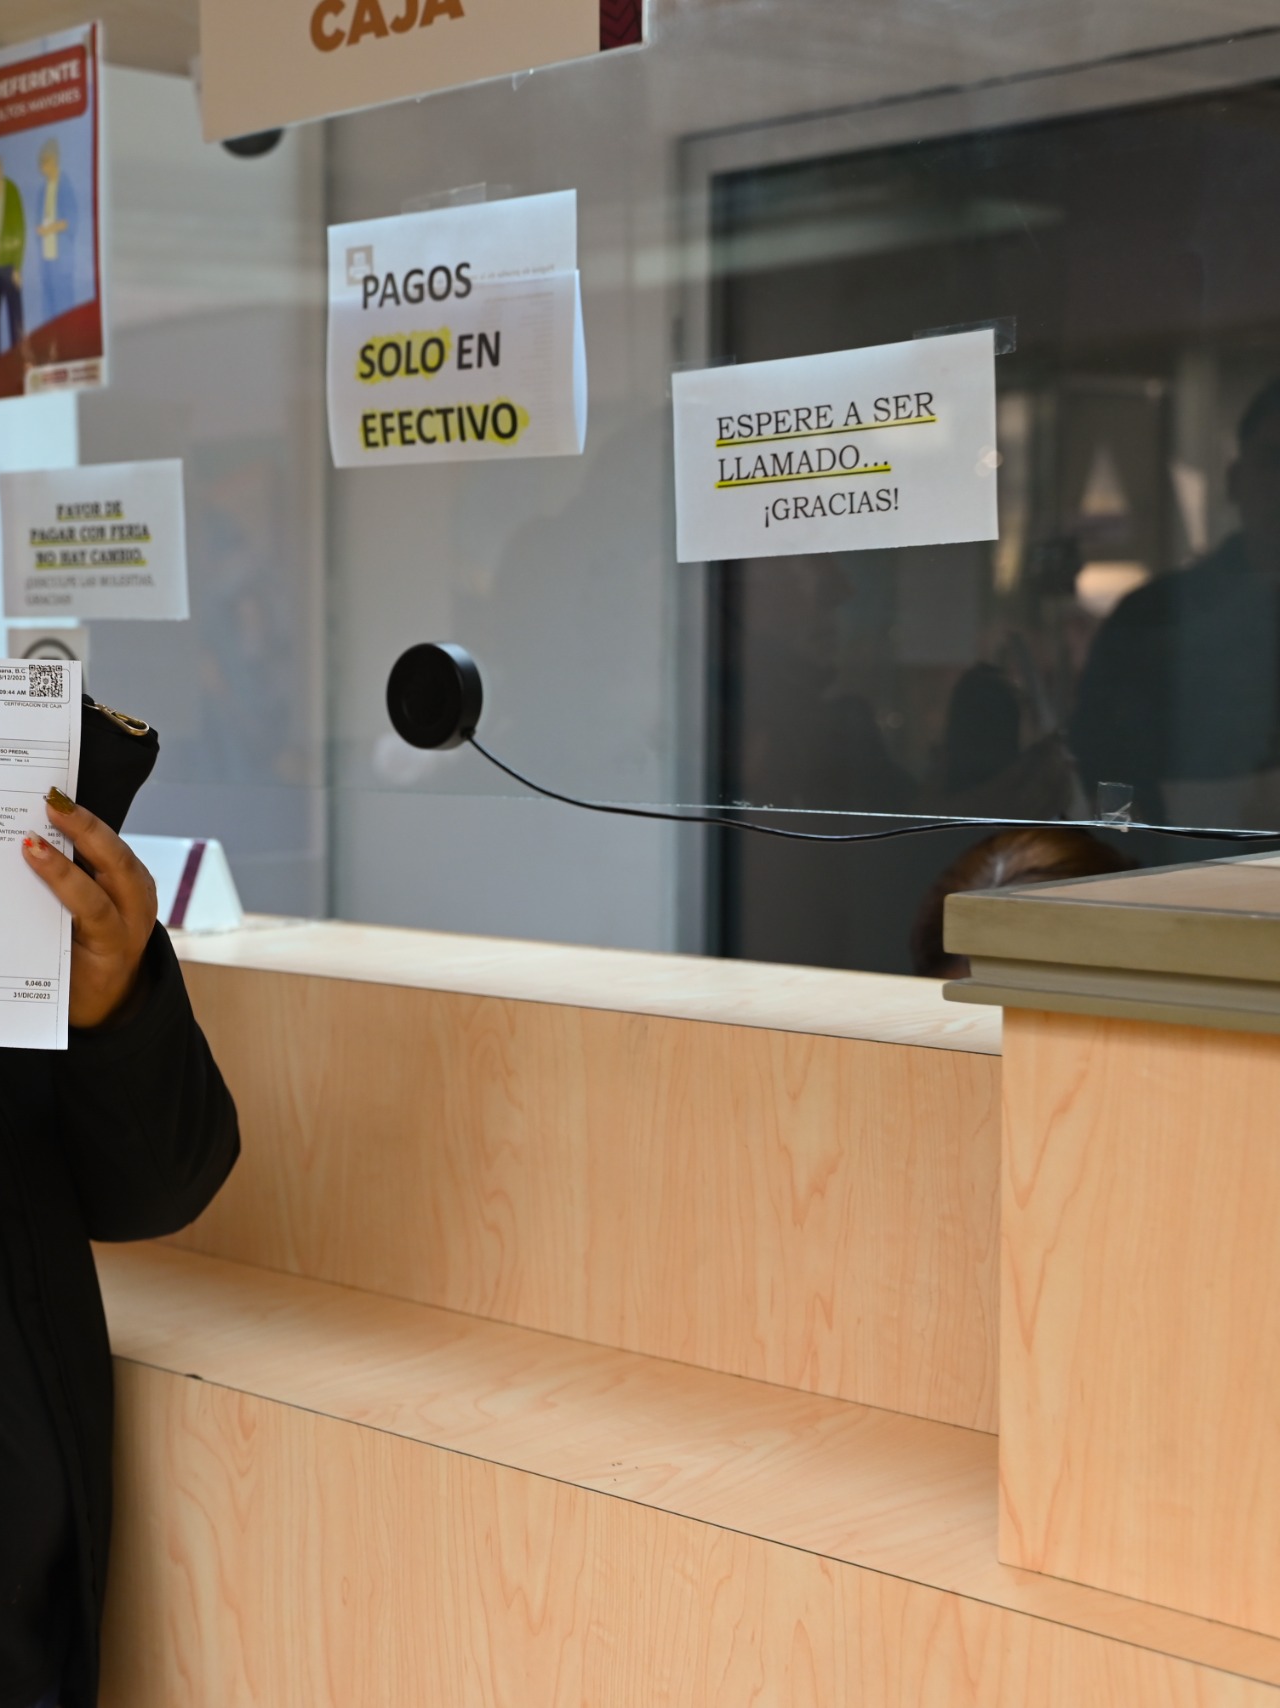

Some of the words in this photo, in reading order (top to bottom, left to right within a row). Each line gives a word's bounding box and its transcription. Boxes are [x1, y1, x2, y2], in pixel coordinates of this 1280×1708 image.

[362, 262, 472, 310] PAGOS
[359, 337, 445, 380] SOLO
[457, 331, 500, 371] EN
[362, 402, 518, 448] EFECTIVO
[716, 405, 834, 440] ESPERE
[843, 401, 863, 426] A
[873, 392, 935, 423] SER
[57, 502, 100, 516] FAVOR
[105, 501, 122, 514] DE
[764, 487, 899, 527] ¡GRACIAS!
[31, 527, 75, 542] PAGAR
[80, 525, 105, 541] CON
[111, 524, 150, 539] FERIA
[36, 551, 55, 565] NO
[60, 549, 85, 564] HAY
[13, 991, 50, 1000] 31/DIC/2023
[25, 980, 51, 988] 6,046.00
